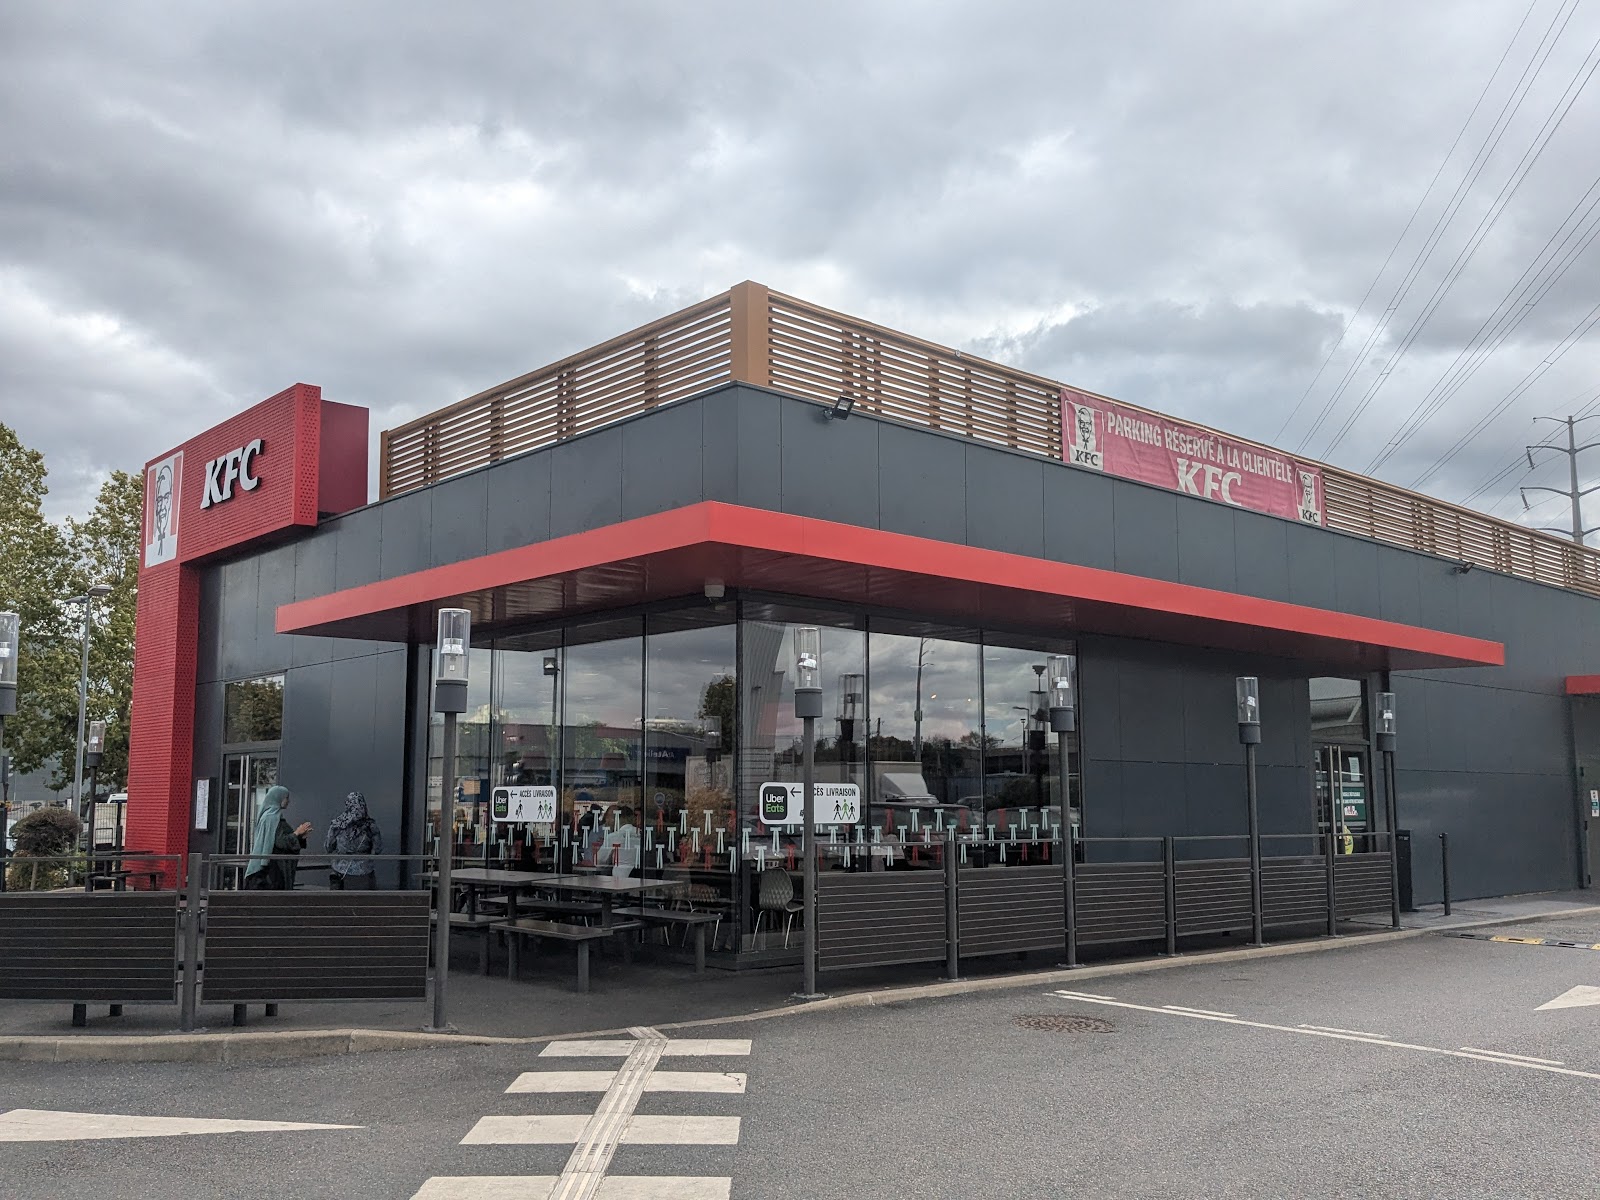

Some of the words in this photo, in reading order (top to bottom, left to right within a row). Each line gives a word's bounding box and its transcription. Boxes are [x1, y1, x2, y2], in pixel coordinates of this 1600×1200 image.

[1107, 411, 1162, 448] PARKING
[1164, 426, 1215, 461] RÉSERVÉ
[1217, 438, 1225, 465] À
[1226, 446, 1240, 469] LA
[1242, 451, 1293, 484] CLIENTÈLE
[1074, 448, 1099, 467] KFC
[199, 438, 263, 510] KFC
[1175, 457, 1242, 506] KFC
[1302, 508, 1318, 523] KFC
[519, 788, 532, 798] ACCÈS
[533, 789, 554, 798] LIVRAISON
[813, 786, 824, 797] CÈS
[826, 787, 856, 797] LIVRAISON
[495, 796, 507, 804] Uber
[765, 793, 785, 803] Uber
[495, 804, 507, 812] Eats
[765, 803, 785, 813] Eats
